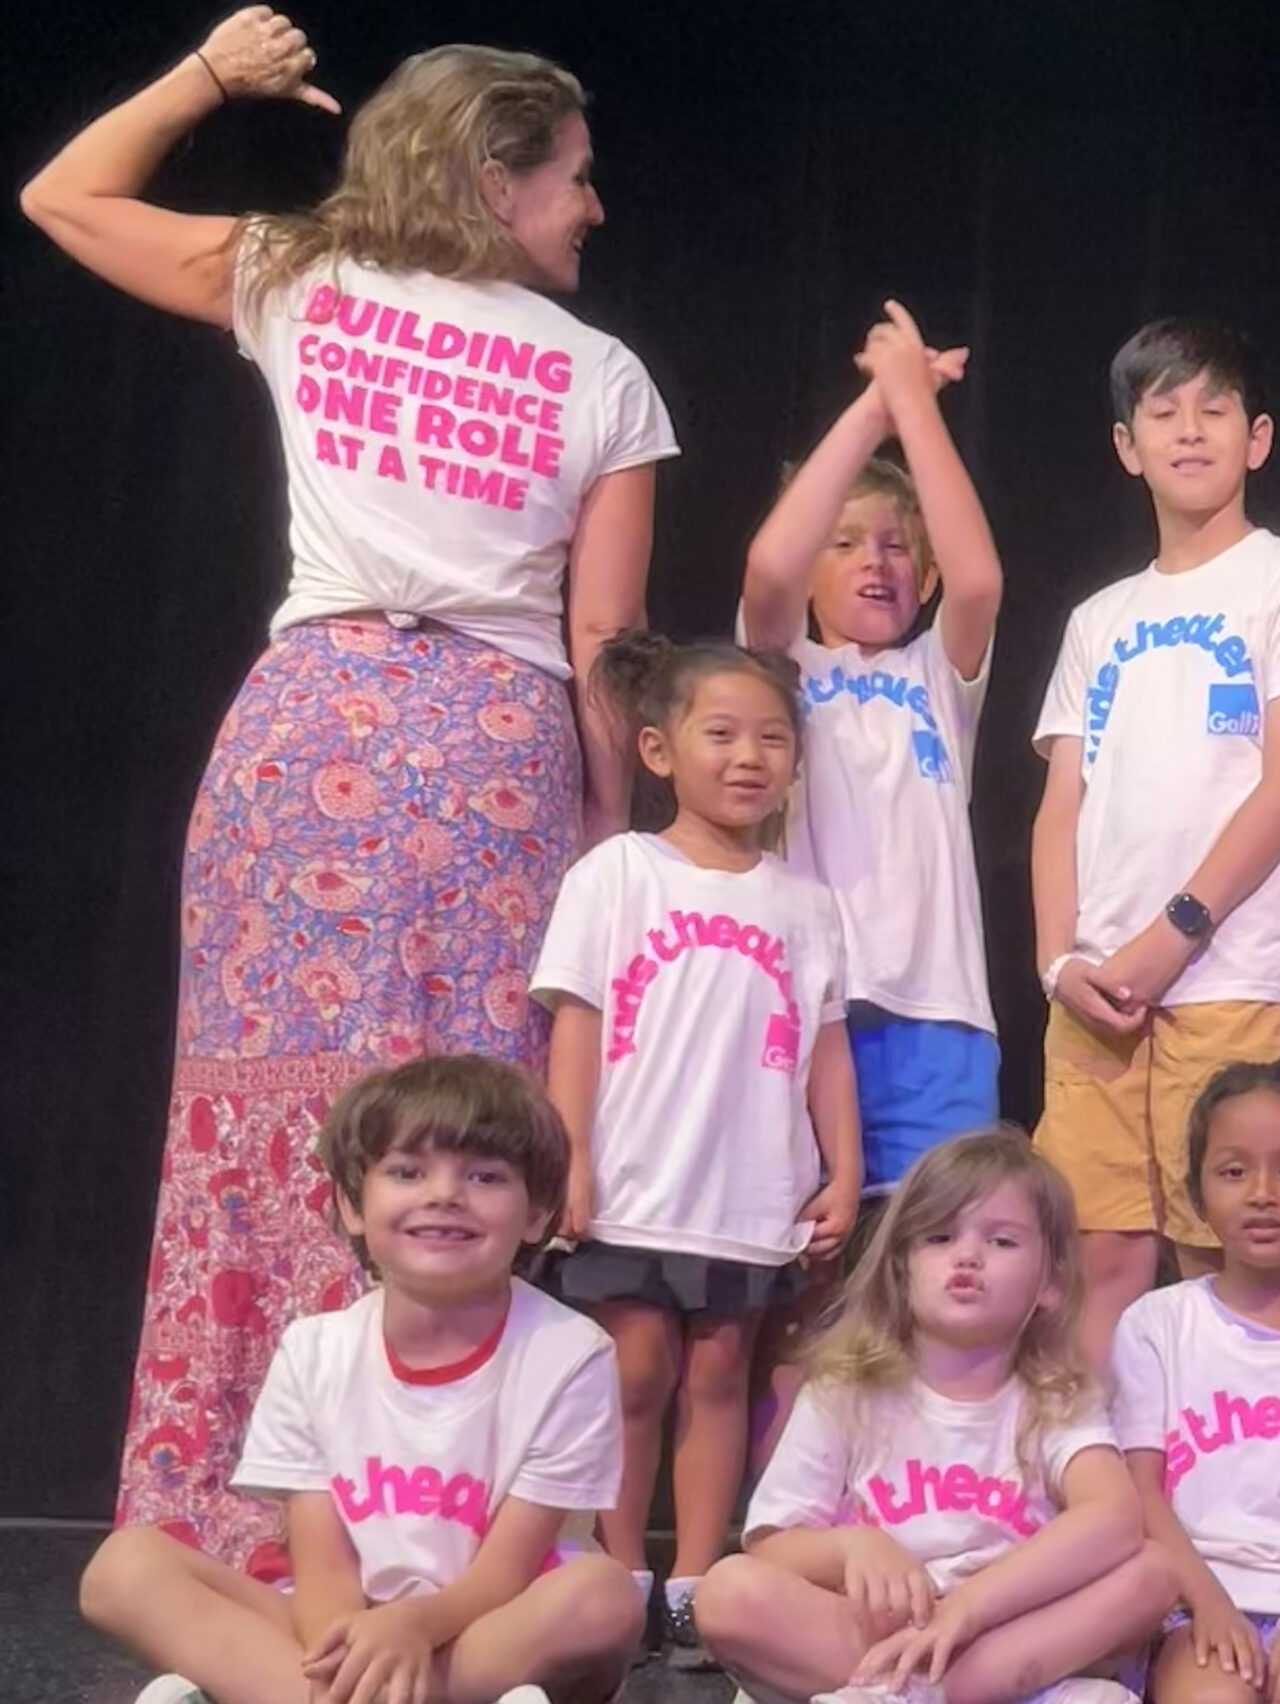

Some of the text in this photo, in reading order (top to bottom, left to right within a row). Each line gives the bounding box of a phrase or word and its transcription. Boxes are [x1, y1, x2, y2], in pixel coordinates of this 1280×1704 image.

[299, 334, 564, 432] CONFIDENCE
[305, 284, 573, 395] BUILDING
[296, 374, 565, 479] ONE ROLE
[316, 428, 530, 511] AT A TIME
[331, 1455, 488, 1540] thea
